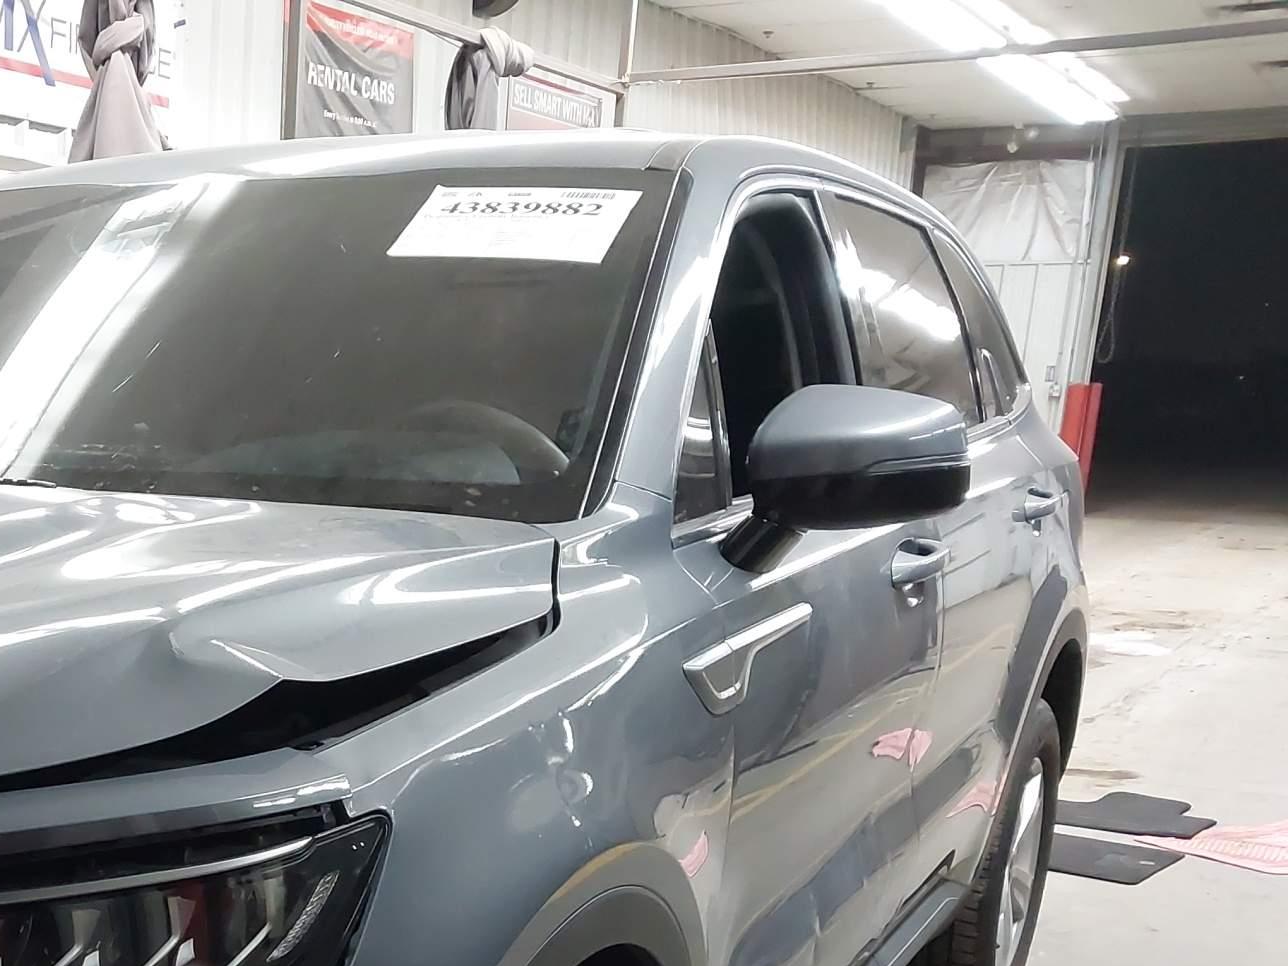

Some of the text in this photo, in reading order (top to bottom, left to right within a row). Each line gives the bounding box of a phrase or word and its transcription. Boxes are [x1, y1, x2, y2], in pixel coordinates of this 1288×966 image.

[308, 61, 395, 104] RENTAL CARS
[514, 83, 532, 107] SELL
[534, 88, 561, 119] SMART
[441, 201, 603, 216] 43839882
